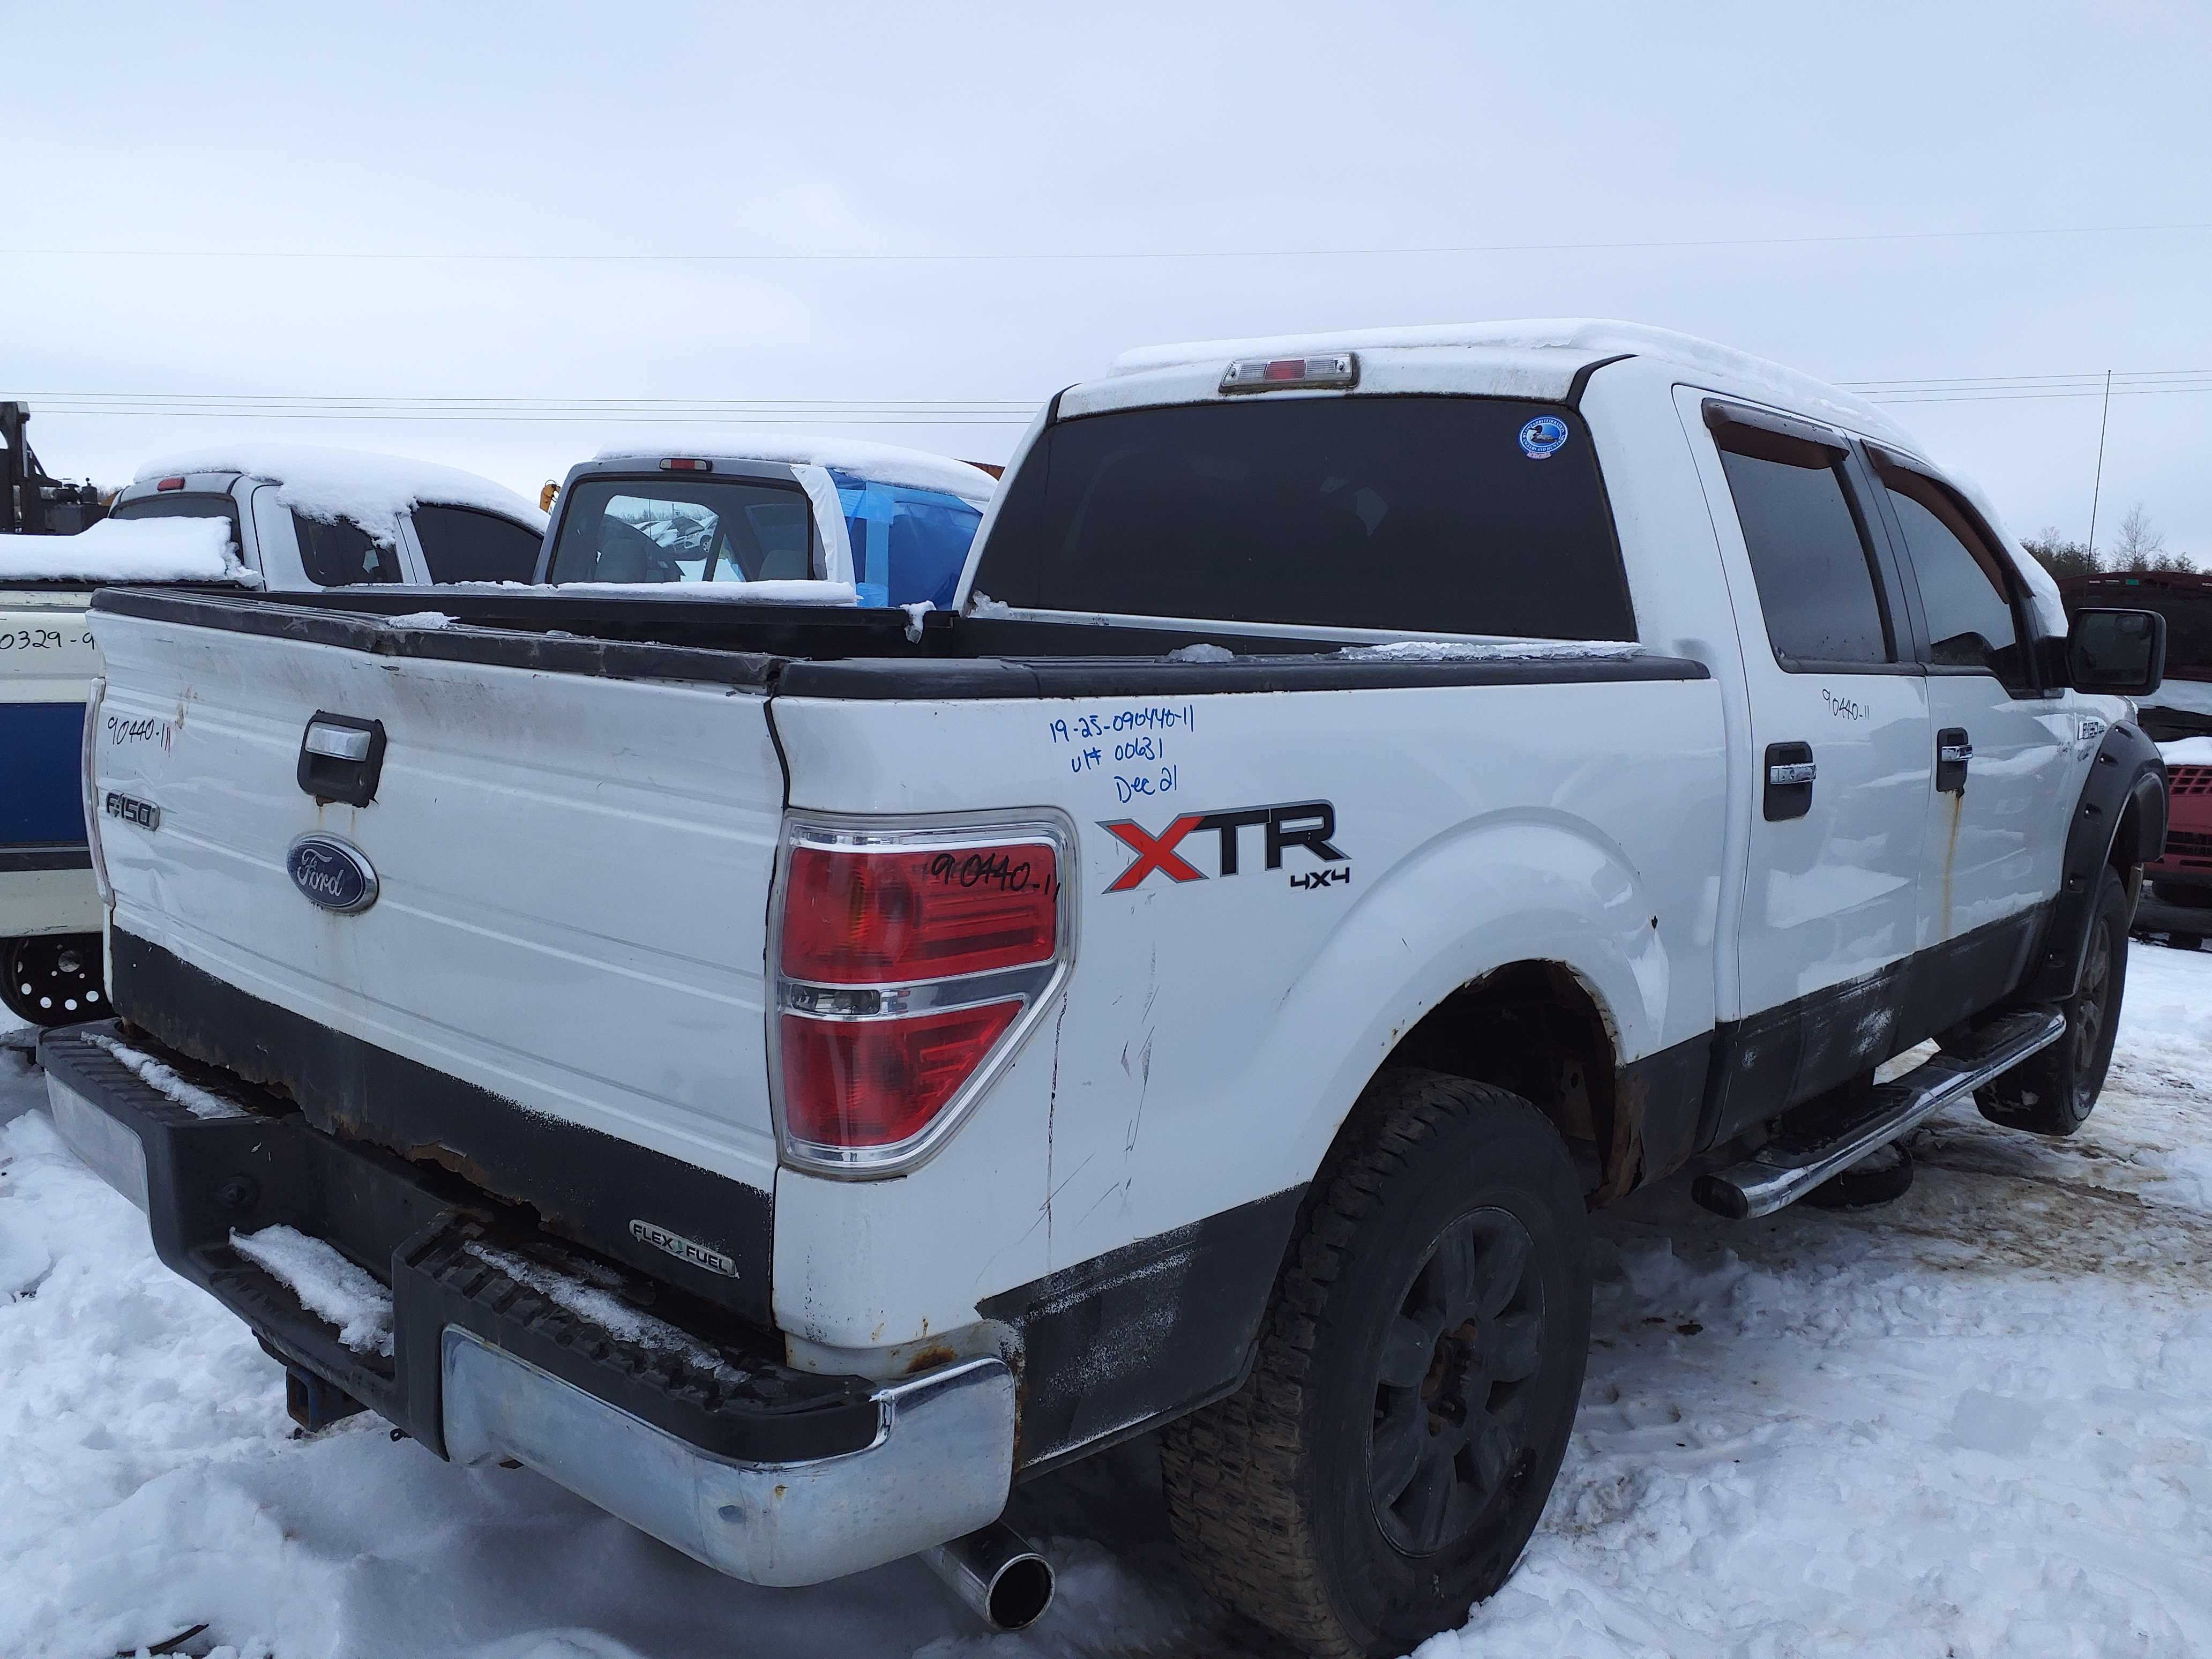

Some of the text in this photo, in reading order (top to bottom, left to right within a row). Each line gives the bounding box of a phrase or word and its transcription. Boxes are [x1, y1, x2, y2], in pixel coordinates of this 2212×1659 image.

[1115, 736, 1162, 761] 00631
[1114, 764, 1177, 803] Dec 21
[1094, 798, 1352, 895] XTR
[297, 848, 345, 897] Ford
[633, 1223, 728, 1273] FLEX FUEL
